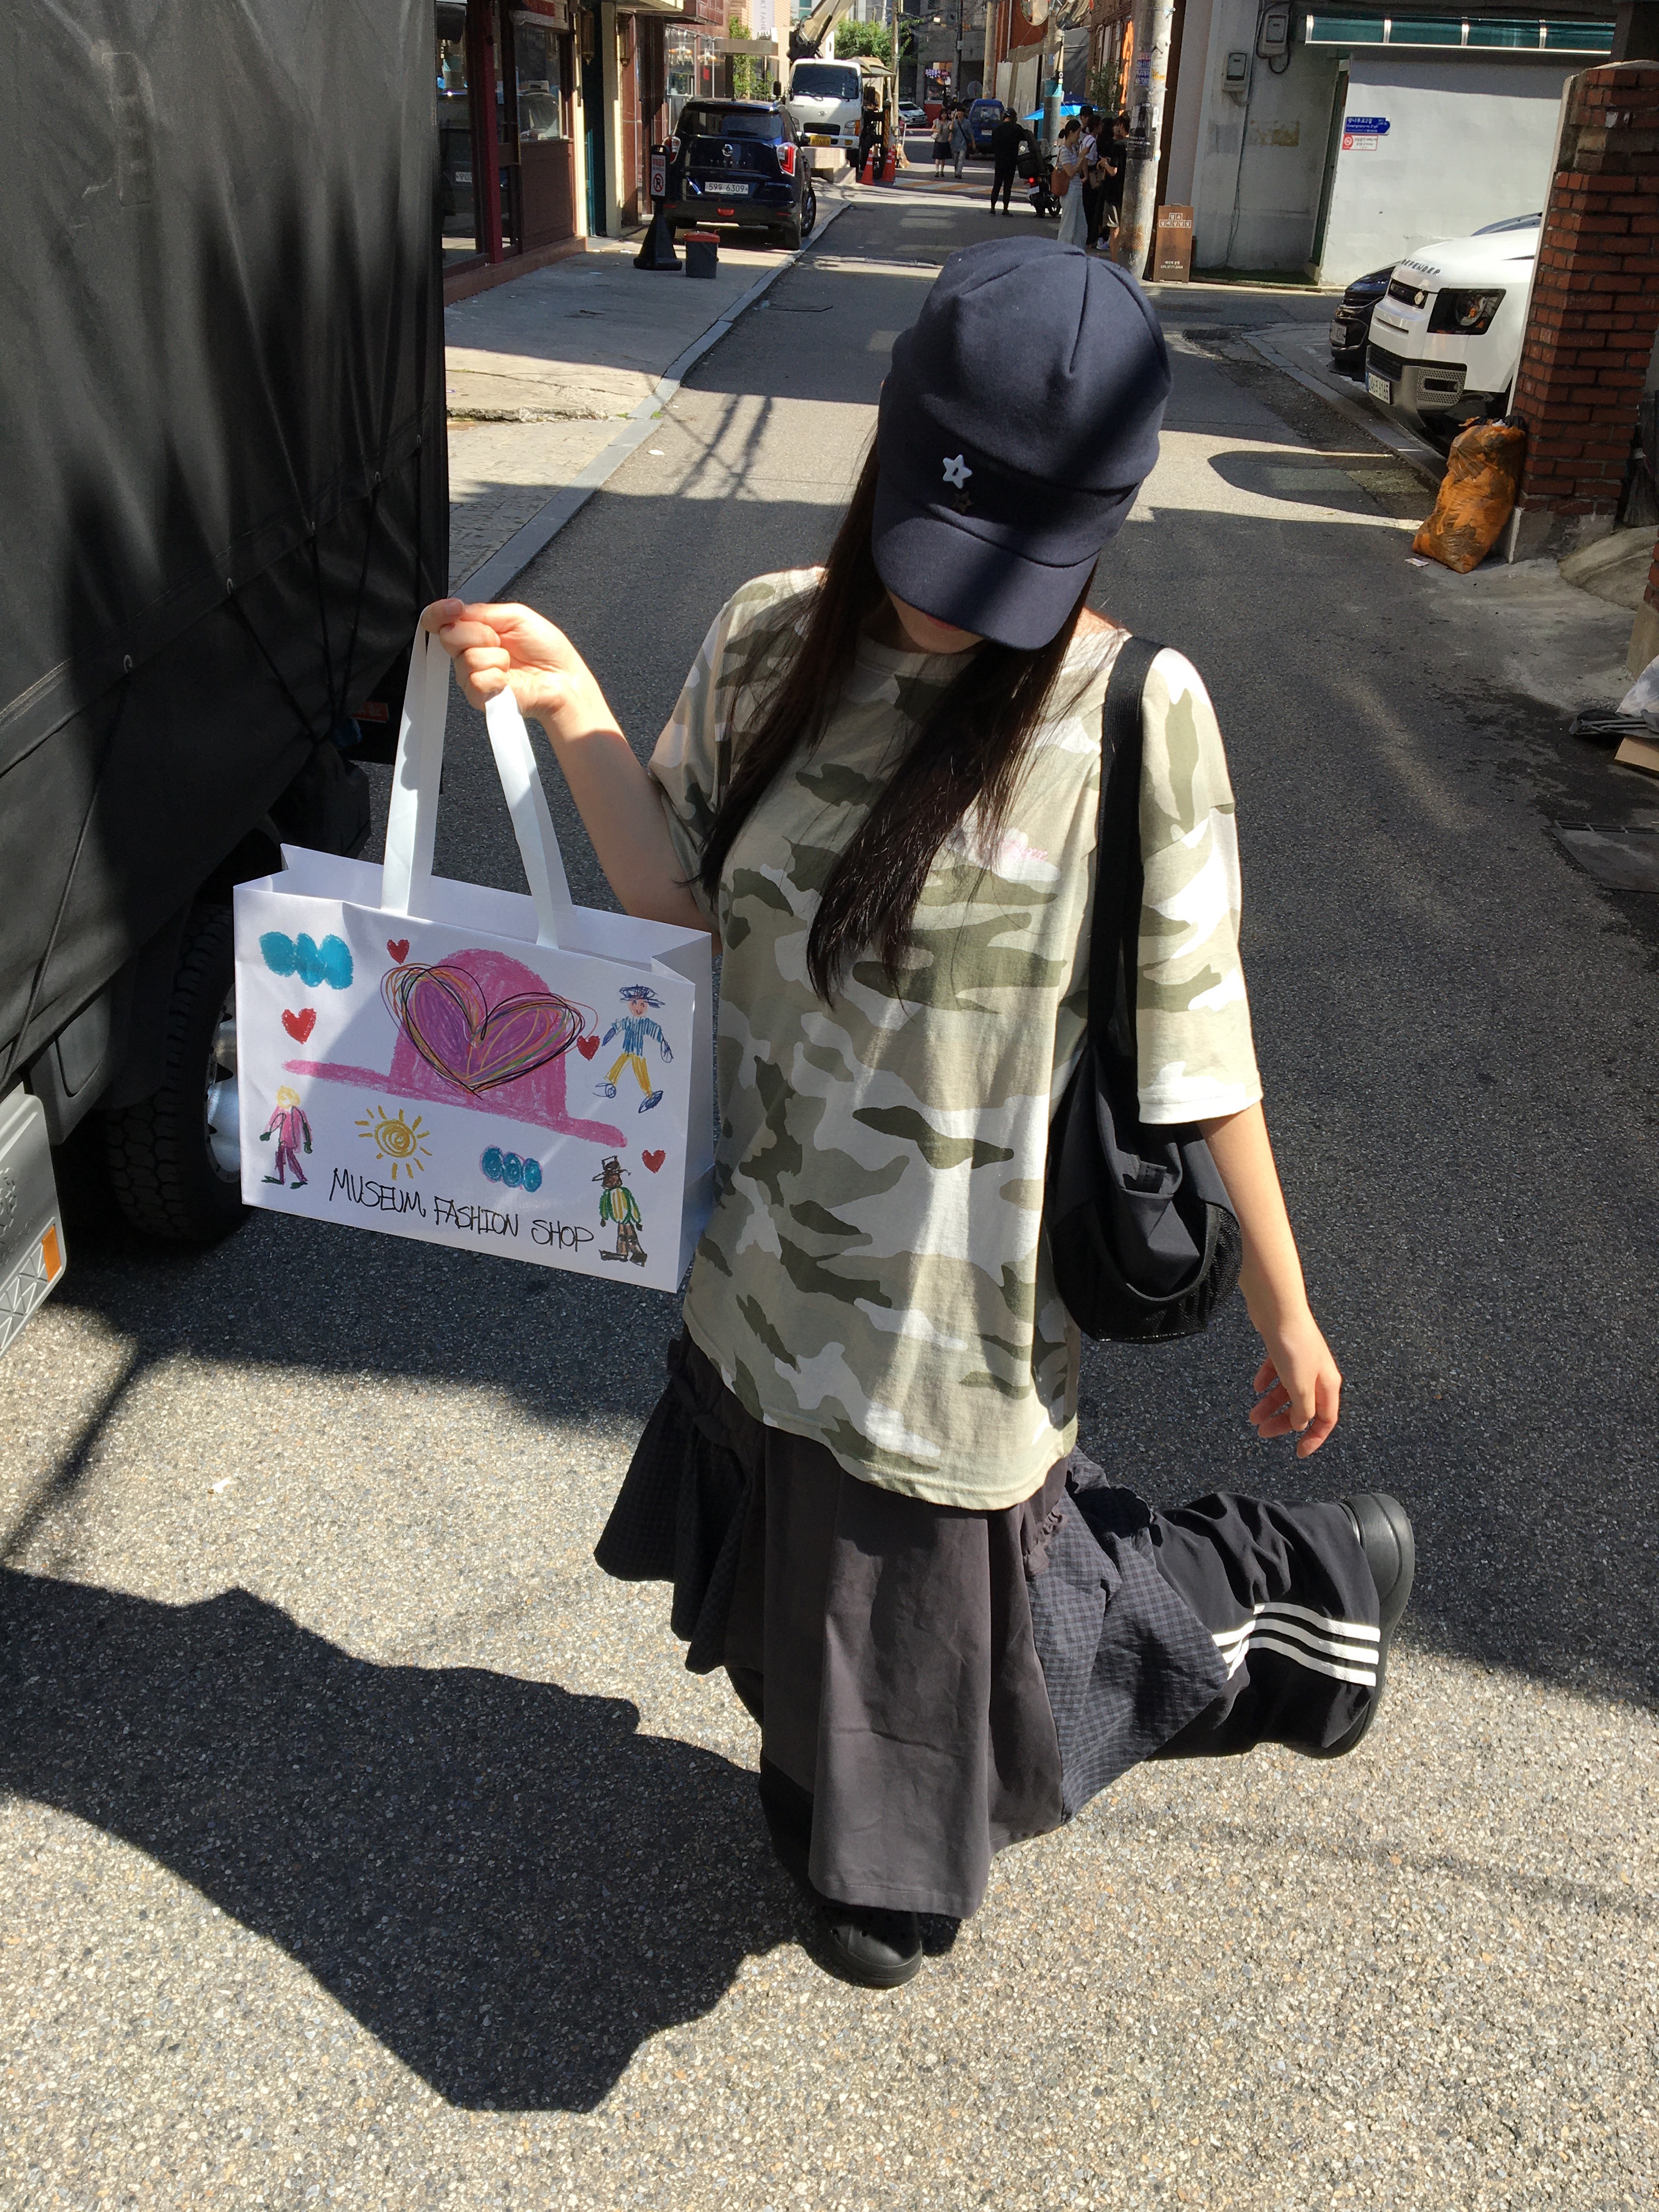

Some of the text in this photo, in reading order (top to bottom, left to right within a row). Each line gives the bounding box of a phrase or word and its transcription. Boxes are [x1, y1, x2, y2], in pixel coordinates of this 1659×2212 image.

[725, 184, 745, 193] 6309
[329, 1167, 595, 1253] MUSEUM FASHION SHOP
